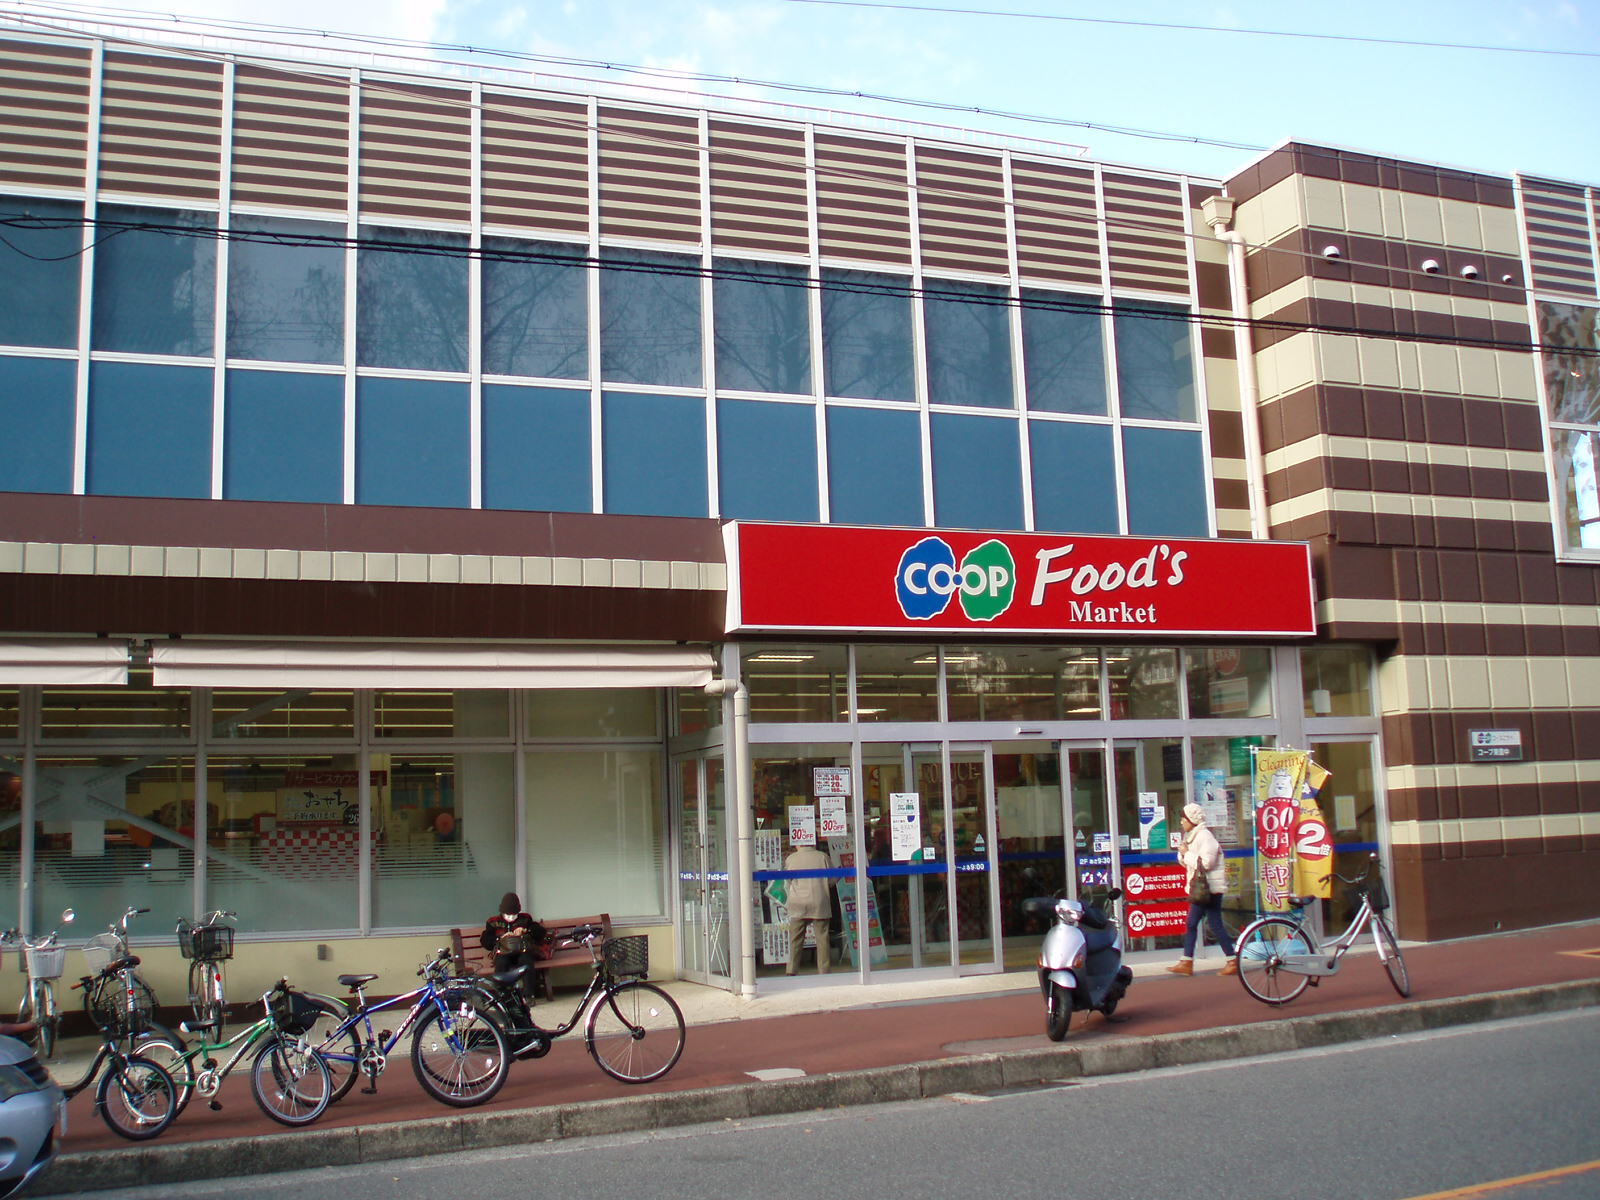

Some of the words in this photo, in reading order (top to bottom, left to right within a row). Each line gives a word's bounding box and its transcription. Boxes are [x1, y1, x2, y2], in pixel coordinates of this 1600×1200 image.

[1030, 543, 1188, 606] Food's
[1068, 600, 1157, 623] Market
[1258, 755, 1306, 772] Cleaning
[1261, 861, 1290, 886] キャ
